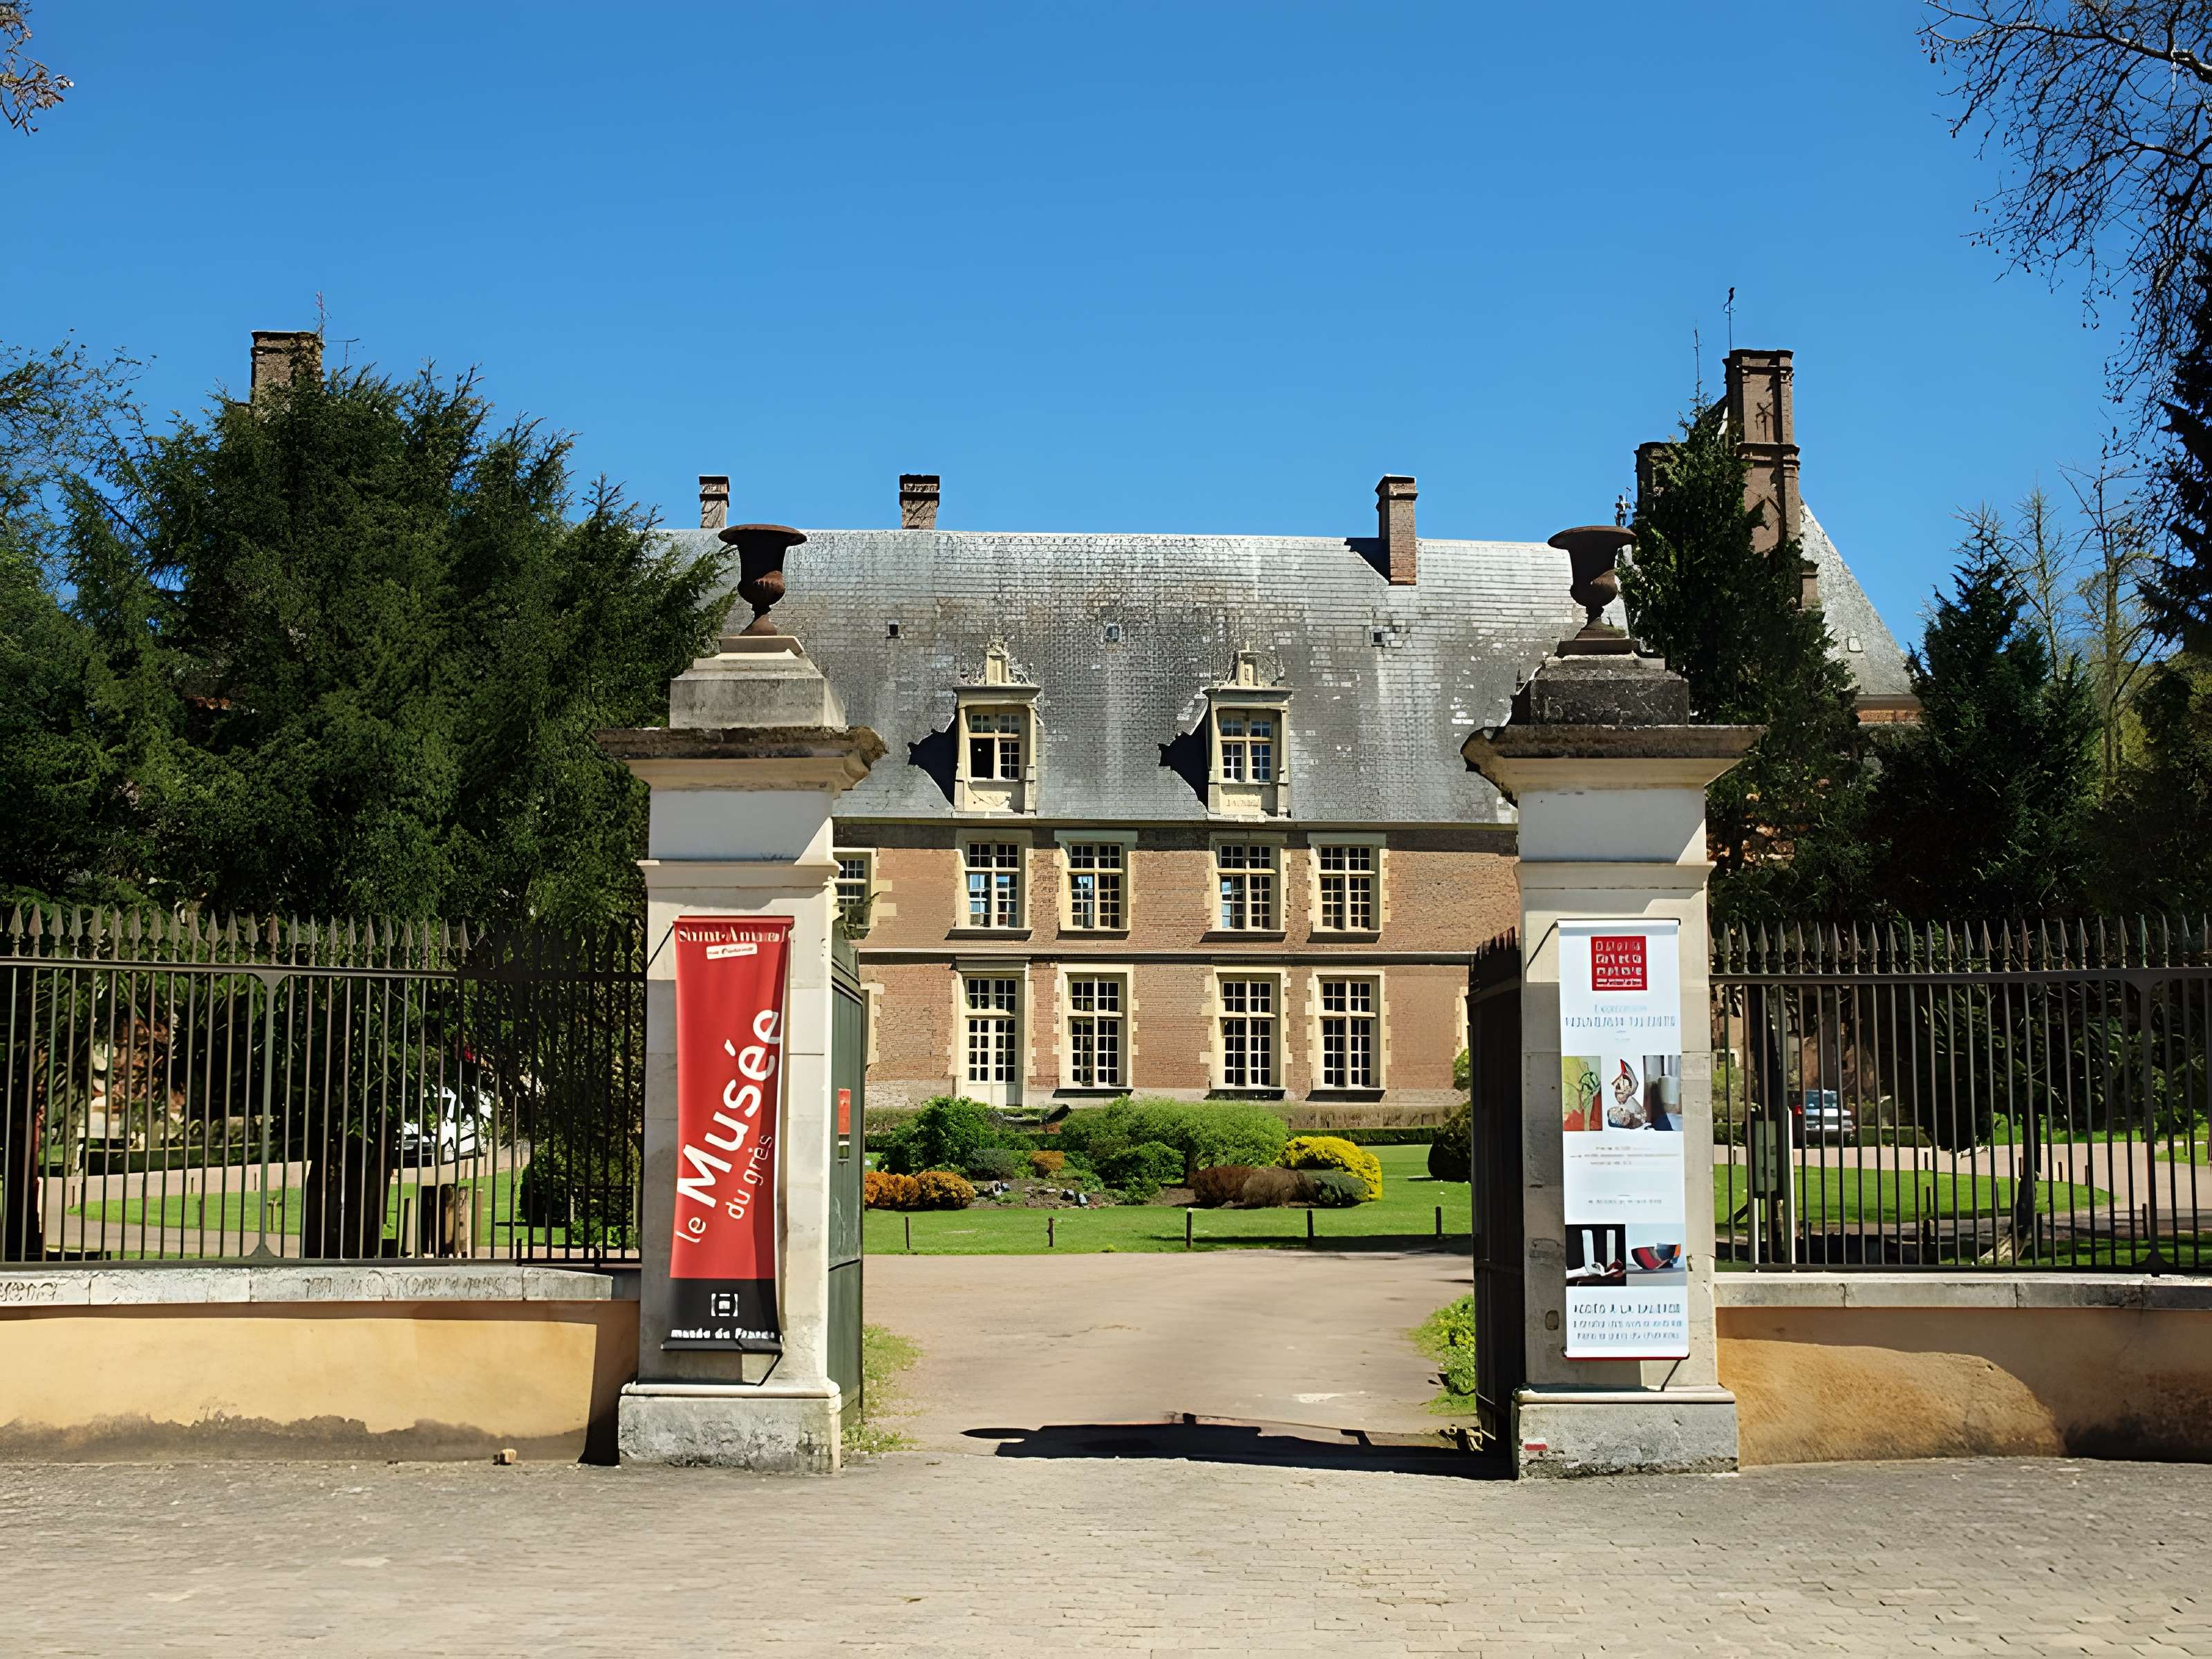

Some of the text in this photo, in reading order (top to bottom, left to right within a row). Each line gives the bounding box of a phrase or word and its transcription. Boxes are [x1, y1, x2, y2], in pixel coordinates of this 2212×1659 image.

[676, 1009, 781, 1208] Musée
[725, 1134, 773, 1220] du grès
[675, 1216, 707, 1244] le
